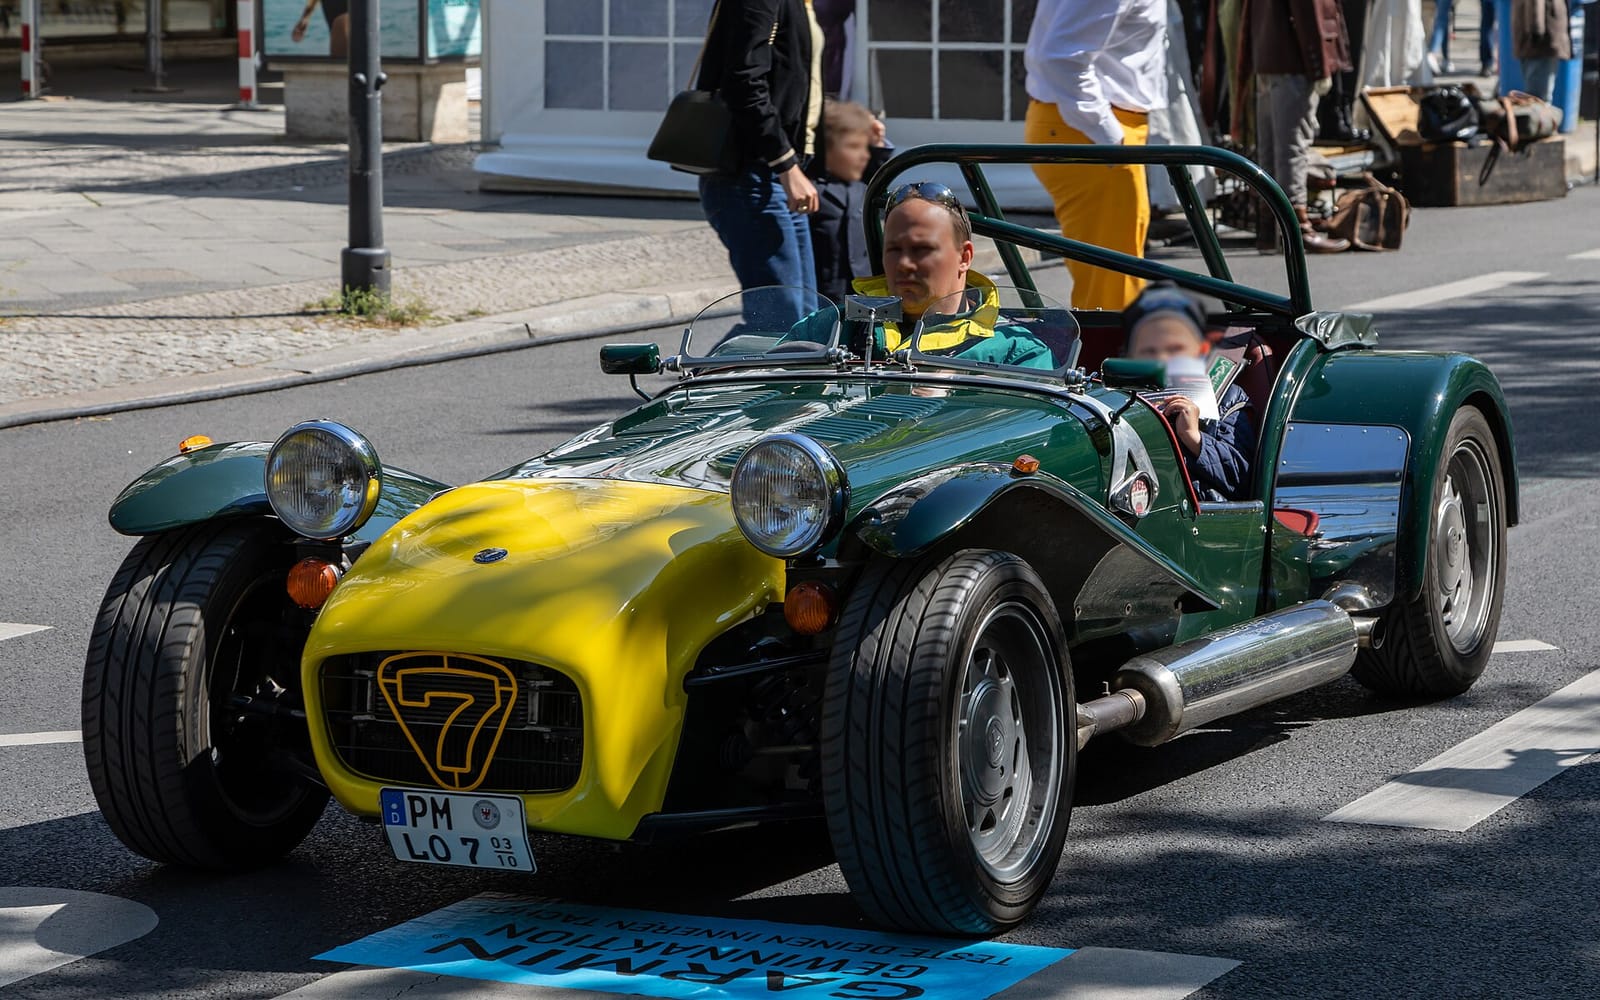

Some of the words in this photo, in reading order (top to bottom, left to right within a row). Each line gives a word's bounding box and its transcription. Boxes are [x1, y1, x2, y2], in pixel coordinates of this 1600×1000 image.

[396, 667, 500, 773] 7
[391, 812, 400, 823] D
[407, 795, 453, 830] PM
[402, 833, 451, 862] LO
[460, 837, 480, 864] 7
[490, 836, 513, 850] 03
[497, 854, 517, 867] 10
[605, 920, 761, 941] INNEREN
[484, 923, 928, 978] GEWINNAKTION
[764, 936, 896, 954] DEINEN
[902, 948, 1012, 966] TESTE
[424, 938, 925, 998] GARMIN
